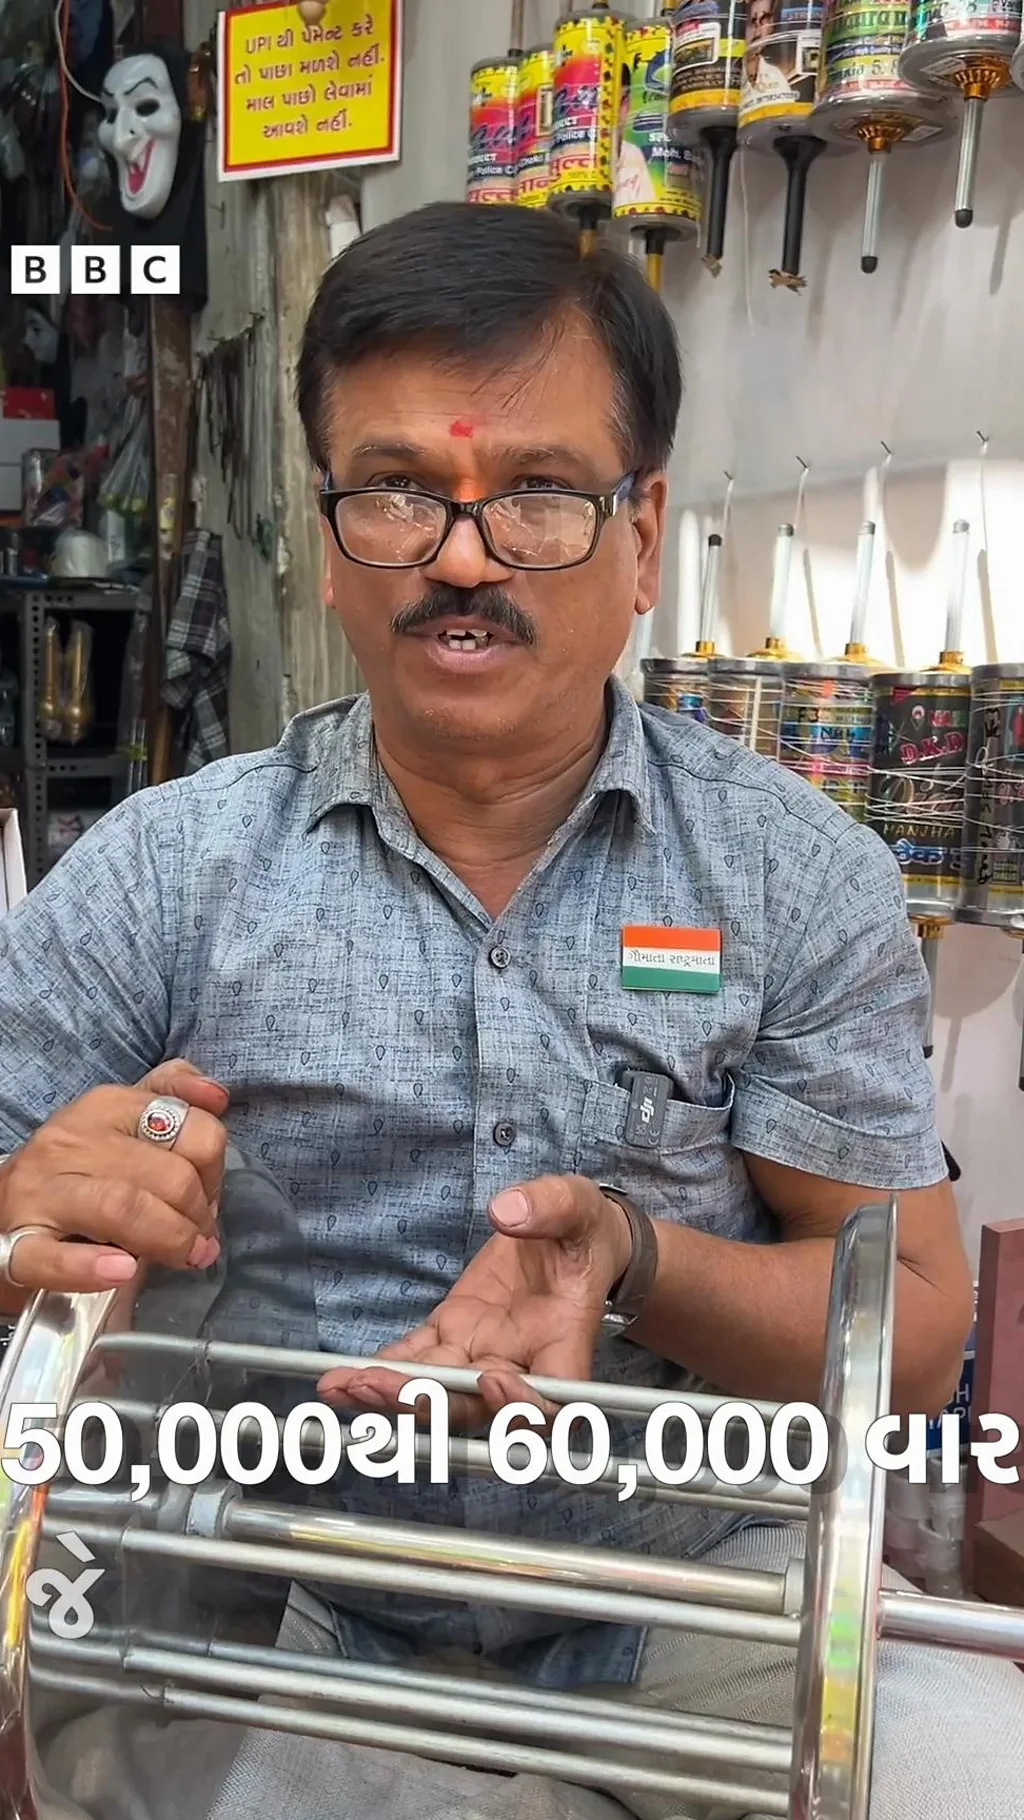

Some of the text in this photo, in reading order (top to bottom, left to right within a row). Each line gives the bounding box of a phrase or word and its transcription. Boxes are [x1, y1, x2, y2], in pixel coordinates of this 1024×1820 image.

[246, 36, 272, 54] UPI
[276, 28, 294, 48] થી
[351, 14, 374, 37] કરે
[235, 63, 252, 85] તો
[259, 63, 293, 80] પાછા
[300, 50, 340, 74] મળશે
[246, 74, 373, 112] માલ પાછો લેવામાં
[262, 114, 309, 139] આવશે
